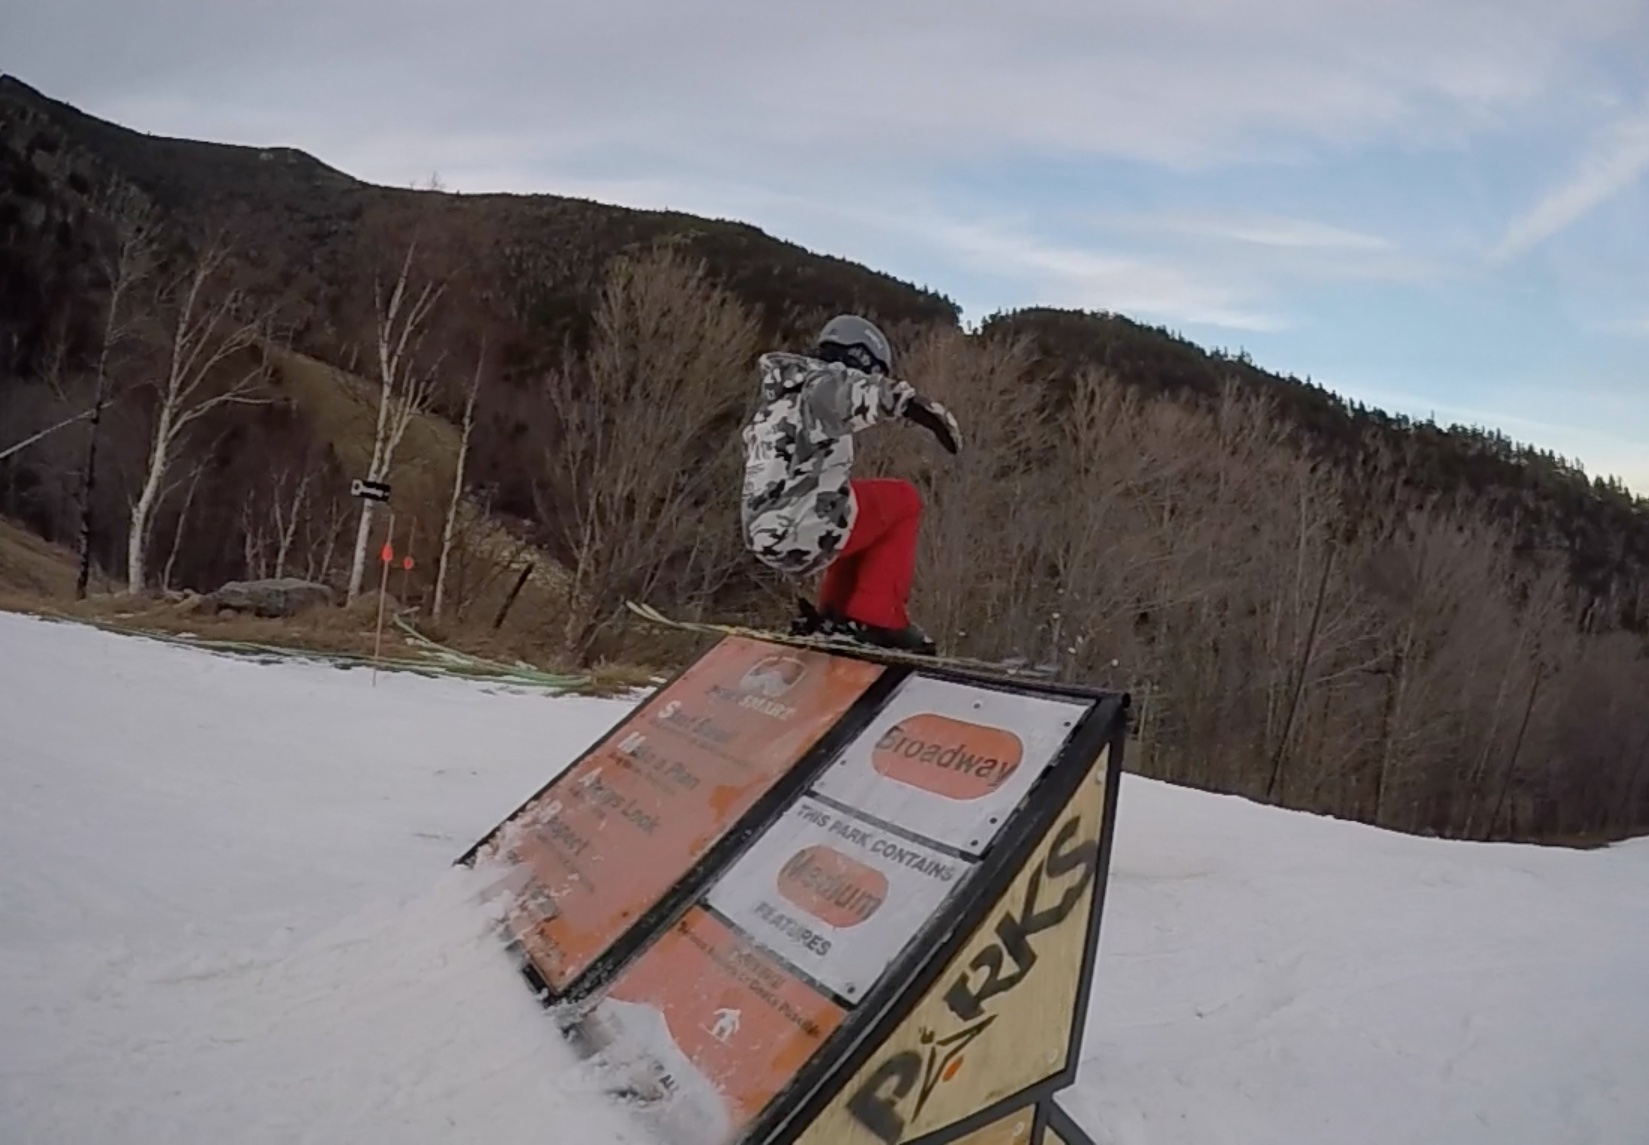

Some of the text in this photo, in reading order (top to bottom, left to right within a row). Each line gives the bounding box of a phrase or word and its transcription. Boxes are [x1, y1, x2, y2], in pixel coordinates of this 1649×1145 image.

[874, 725, 1015, 787] Broadway
[796, 805, 955, 882] THIS PARK CONTAINS
[753, 902, 833, 957] FEATURES
